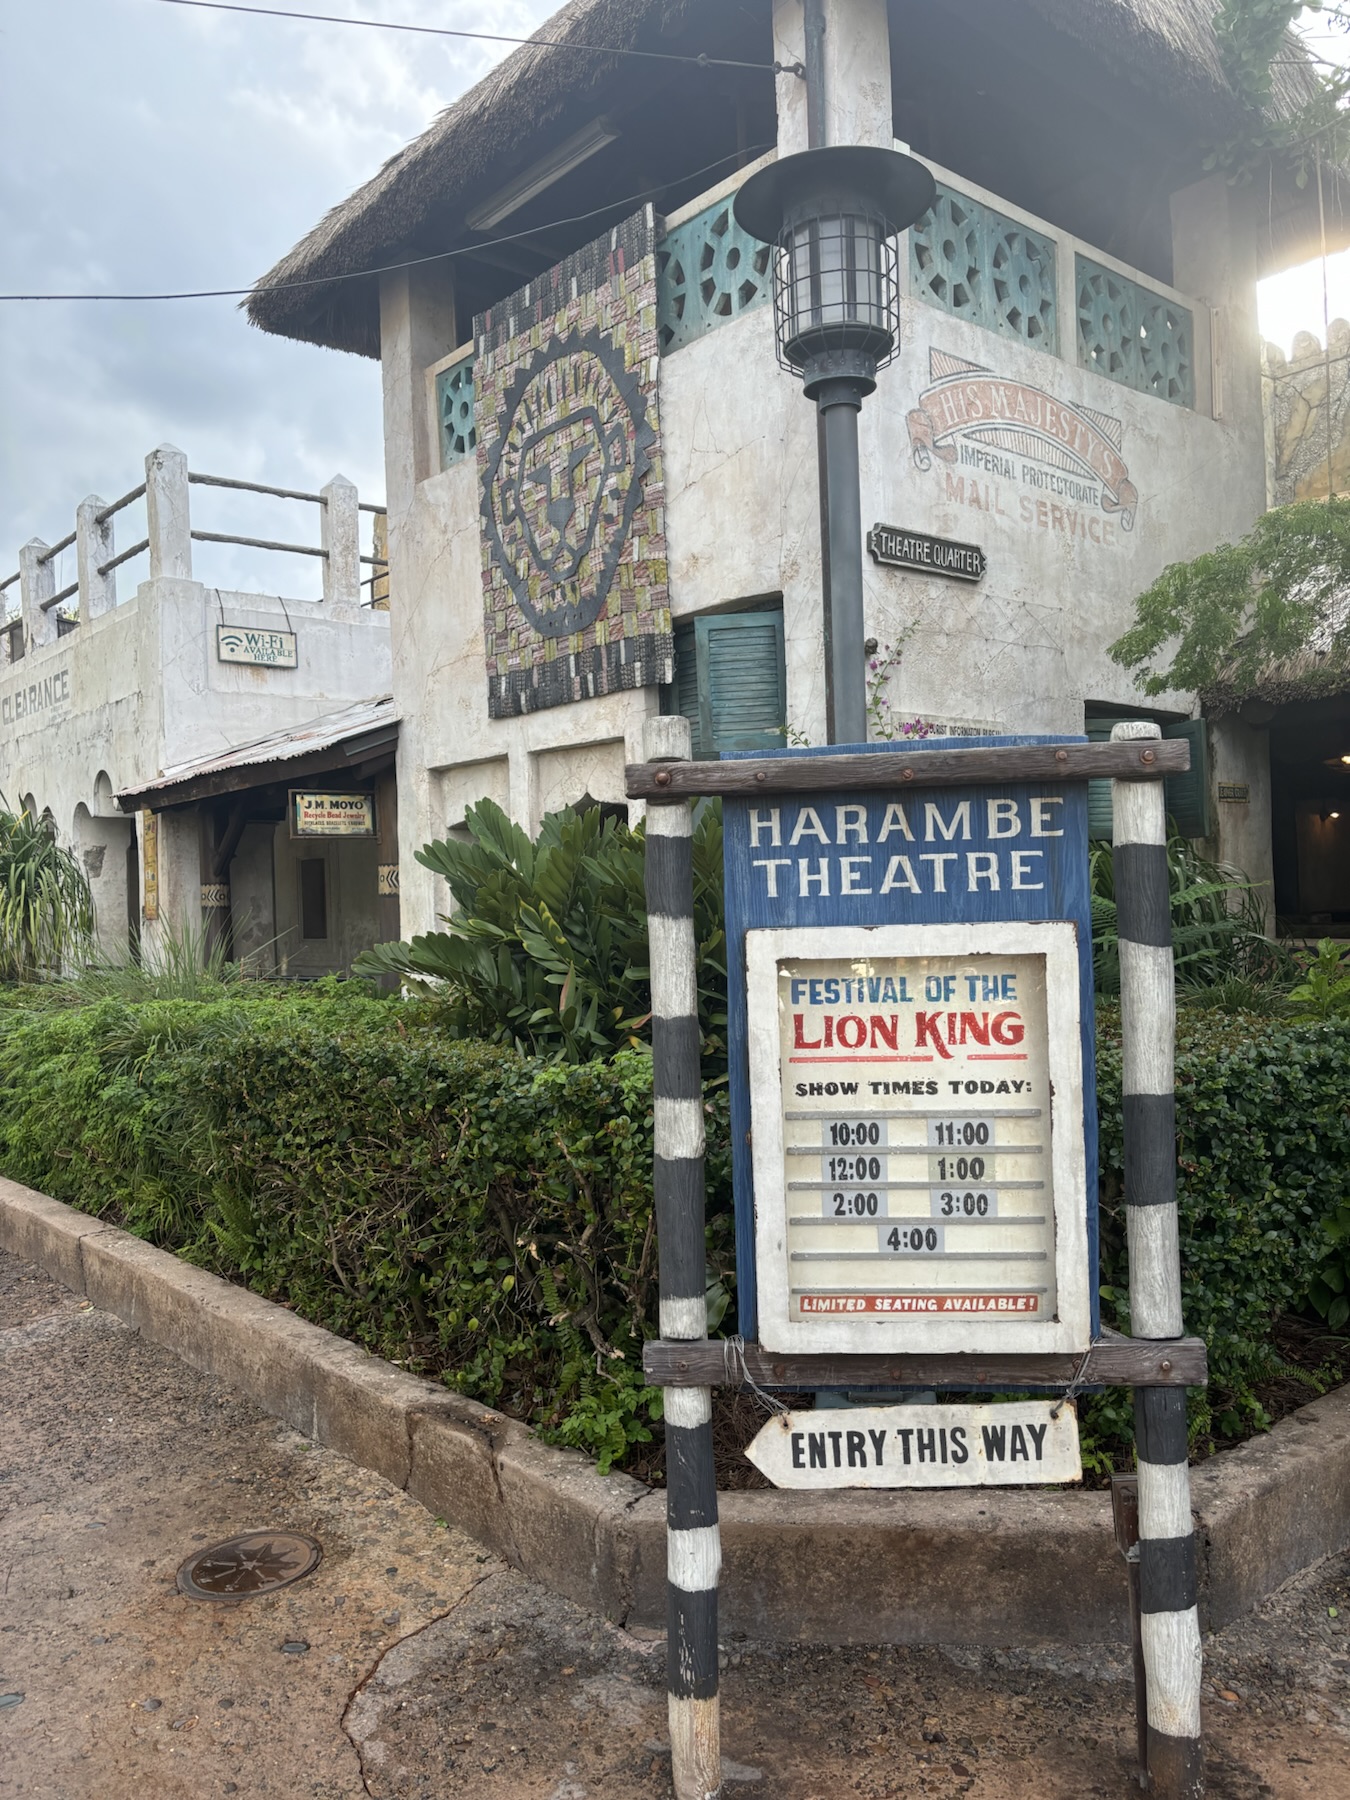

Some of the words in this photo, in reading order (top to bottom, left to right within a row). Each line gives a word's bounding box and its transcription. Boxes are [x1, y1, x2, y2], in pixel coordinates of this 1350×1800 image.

[938, 384, 984, 427] HIS
[989, 384, 1116, 480] MAJESTY'S
[960, 443, 1017, 481] IMPERIAL
[1022, 464, 1099, 507] PROTECTORATE
[944, 472, 1006, 516] MAIL
[1019, 495, 1117, 547] SERVICE
[879, 531, 932, 564] THEATRE
[933, 544, 981, 574] QUARTER
[243, 632, 285, 650] Wi-Fi
[243, 646, 294, 659] AVAILABLE
[253, 653, 279, 663] HERE
[1, 668, 70, 726] CLEARANCE
[303, 811, 327, 821] Recycle
[326, 811, 342, 819] Bead
[304, 800, 328, 811] J.M.
[329, 800, 365, 811] MOYO
[748, 796, 1065, 848] HARAMBE
[752, 850, 1045, 898] THEATRE
[790, 975, 914, 1006] FESTIVAL
[924, 974, 957, 1002] OF
[964, 973, 1018, 1001] THE
[792, 1012, 900, 1051] LION
[915, 1010, 1026, 1060] KING
[794, 1081, 860, 1097] SHOW
[867, 1080, 939, 1097] TIMES
[948, 1079, 1033, 1096] TODAY:
[829, 1121, 880, 1146] 10:00
[934, 1121, 990, 1146] 11:00
[828, 1156, 881, 1181] 12:00
[936, 1156, 985, 1181] 1:00
[832, 1192, 879, 1217] 2:00
[940, 1192, 989, 1217] 3:00
[886, 1227, 938, 1252] 4:00
[802, 1298, 867, 1312] LIMITED
[873, 1298, 939, 1312] SEATING
[942, 1297, 1036, 1312] AVAILABLE!
[790, 1428, 888, 1469] ENTRY
[896, 1426, 970, 1466] THIS
[980, 1423, 1048, 1462] WAY
